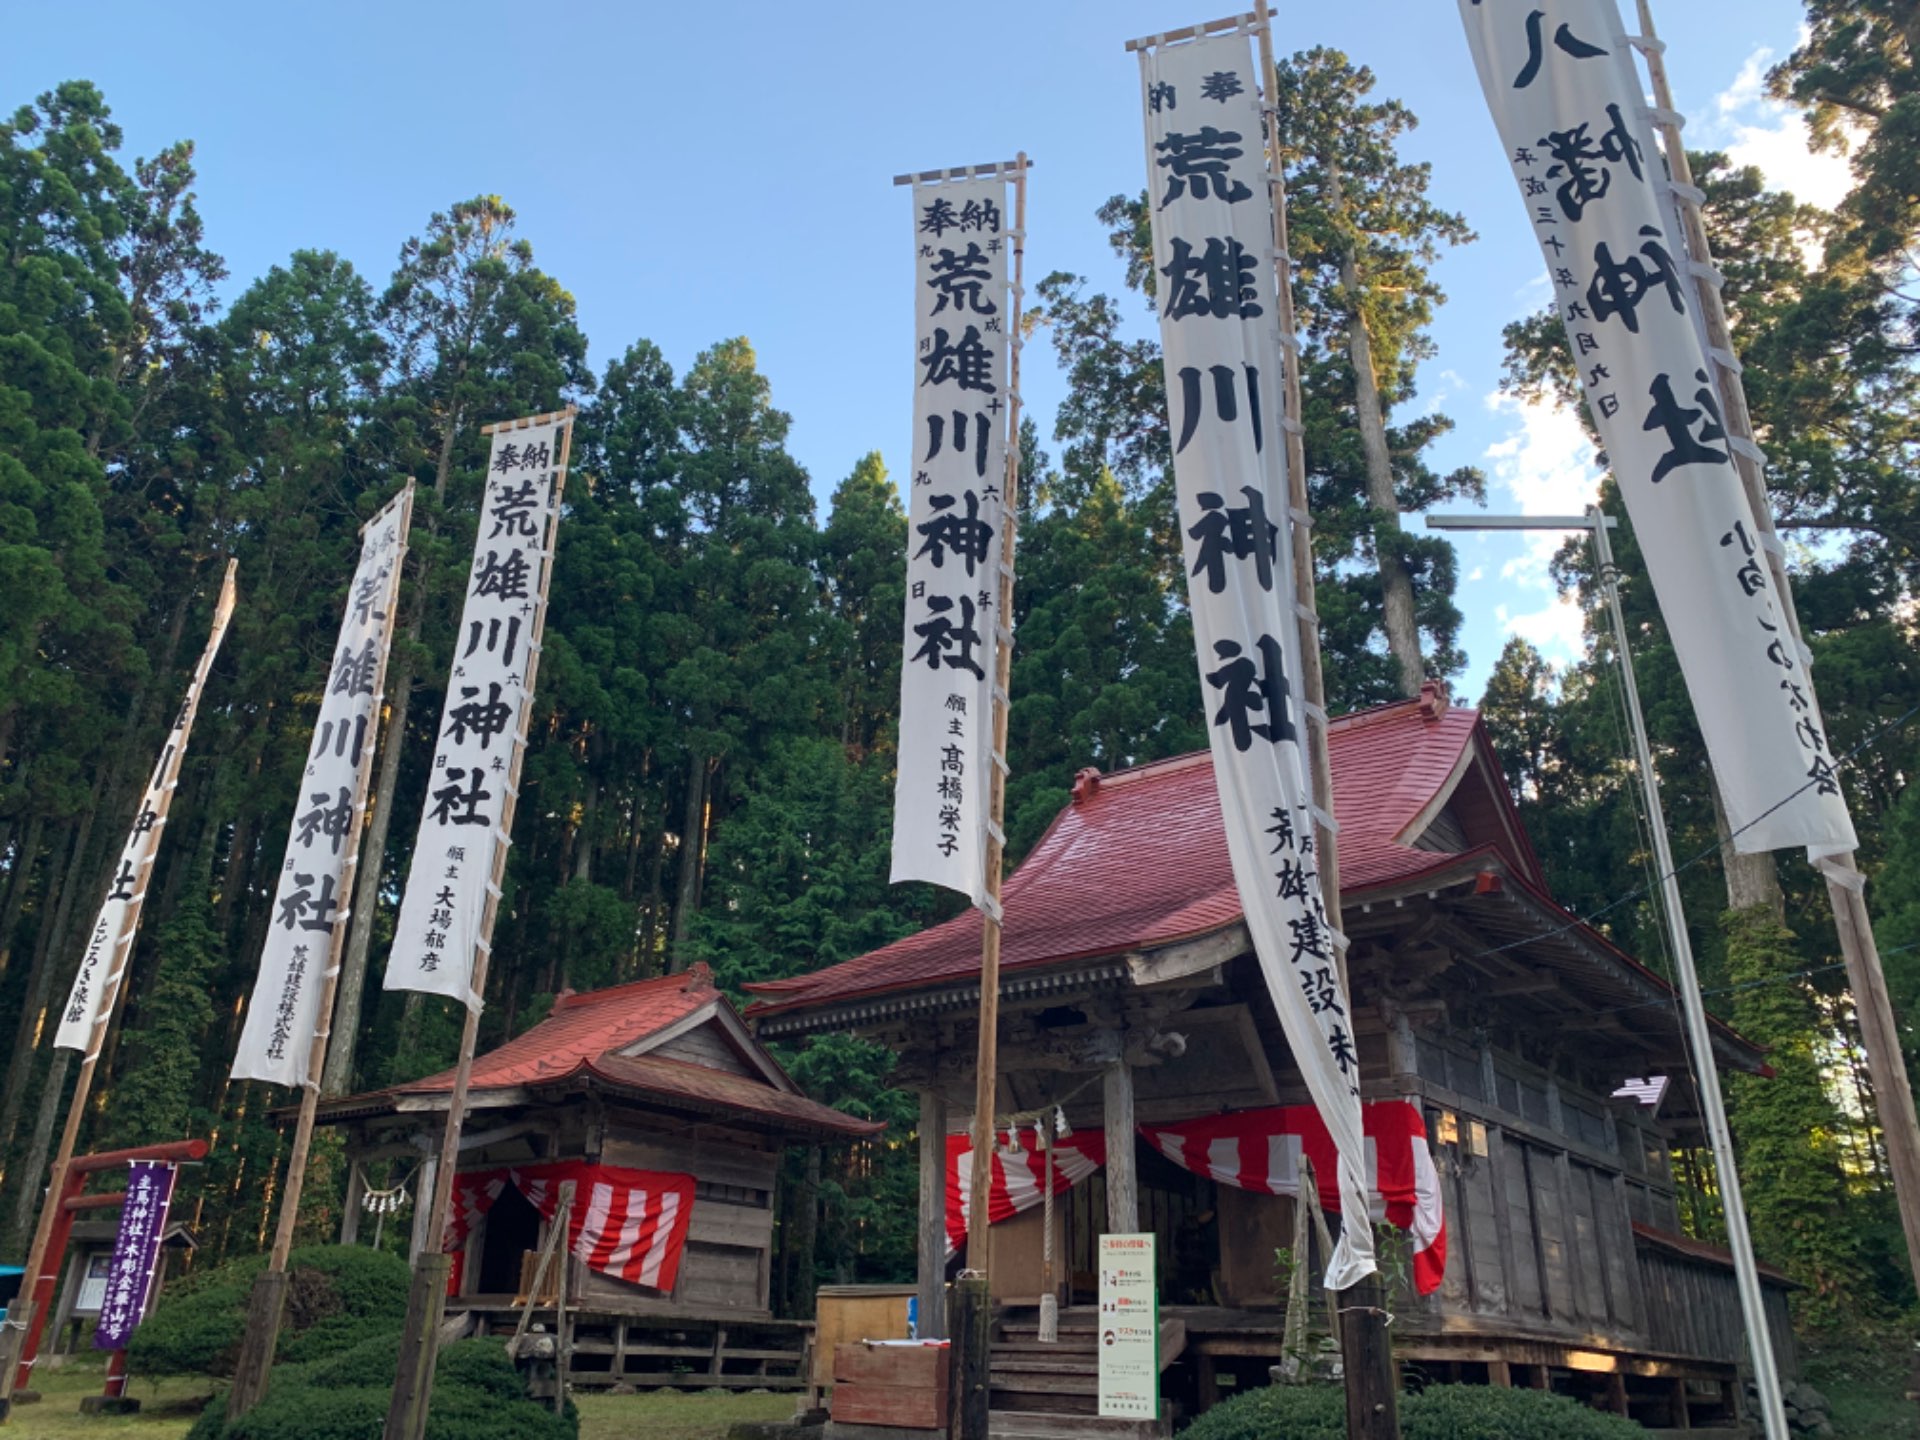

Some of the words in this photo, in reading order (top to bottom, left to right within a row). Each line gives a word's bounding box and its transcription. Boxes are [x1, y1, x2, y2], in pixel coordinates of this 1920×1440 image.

[918, 197, 1001, 238] 奉納
[490, 440, 550, 476] 奉納
[909, 241, 998, 682] 荒雄川神社
[1154, 125, 1298, 754] 荒雄川神社
[275, 565, 388, 936] 荒雄川神社
[427, 479, 540, 827] 荒雄川神社
